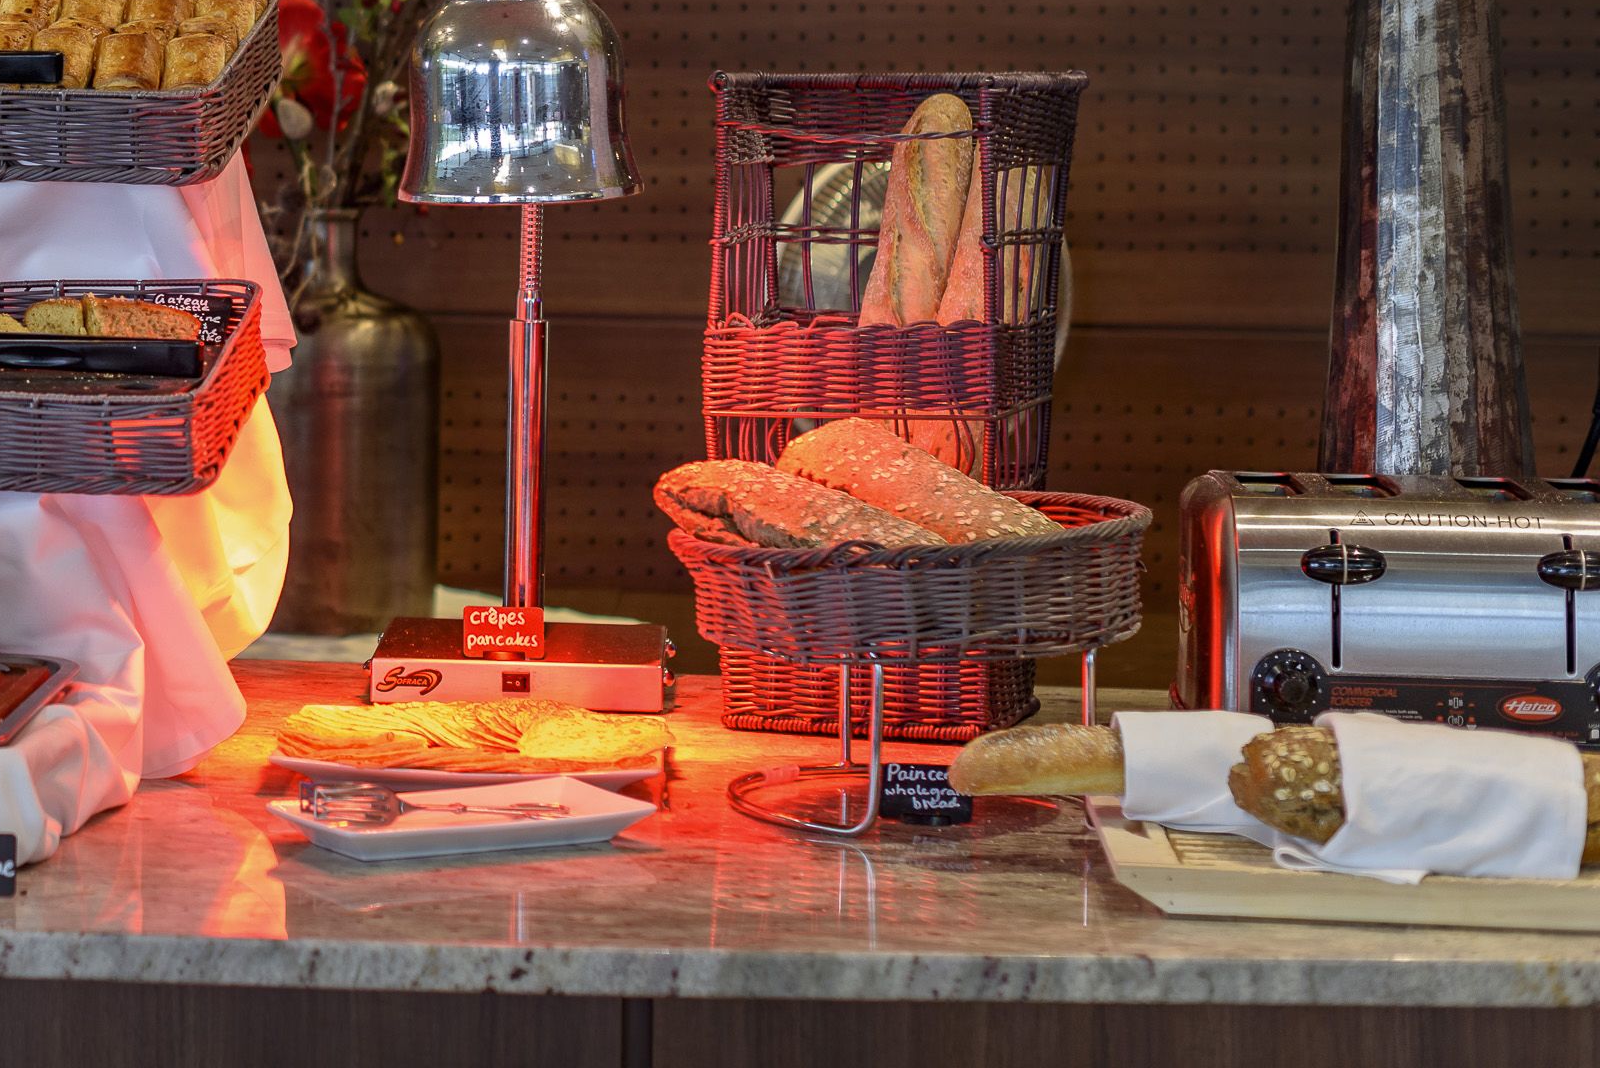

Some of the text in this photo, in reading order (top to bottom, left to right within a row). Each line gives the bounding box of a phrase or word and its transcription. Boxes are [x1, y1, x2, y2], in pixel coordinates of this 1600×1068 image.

[1384, 512, 1546, 530] CAUTION-HOT
[469, 607, 526, 630] crêpes
[467, 632, 539, 650] pancakes
[1505, 699, 1558, 716] Hatco
[887, 763, 927, 782] Pain
